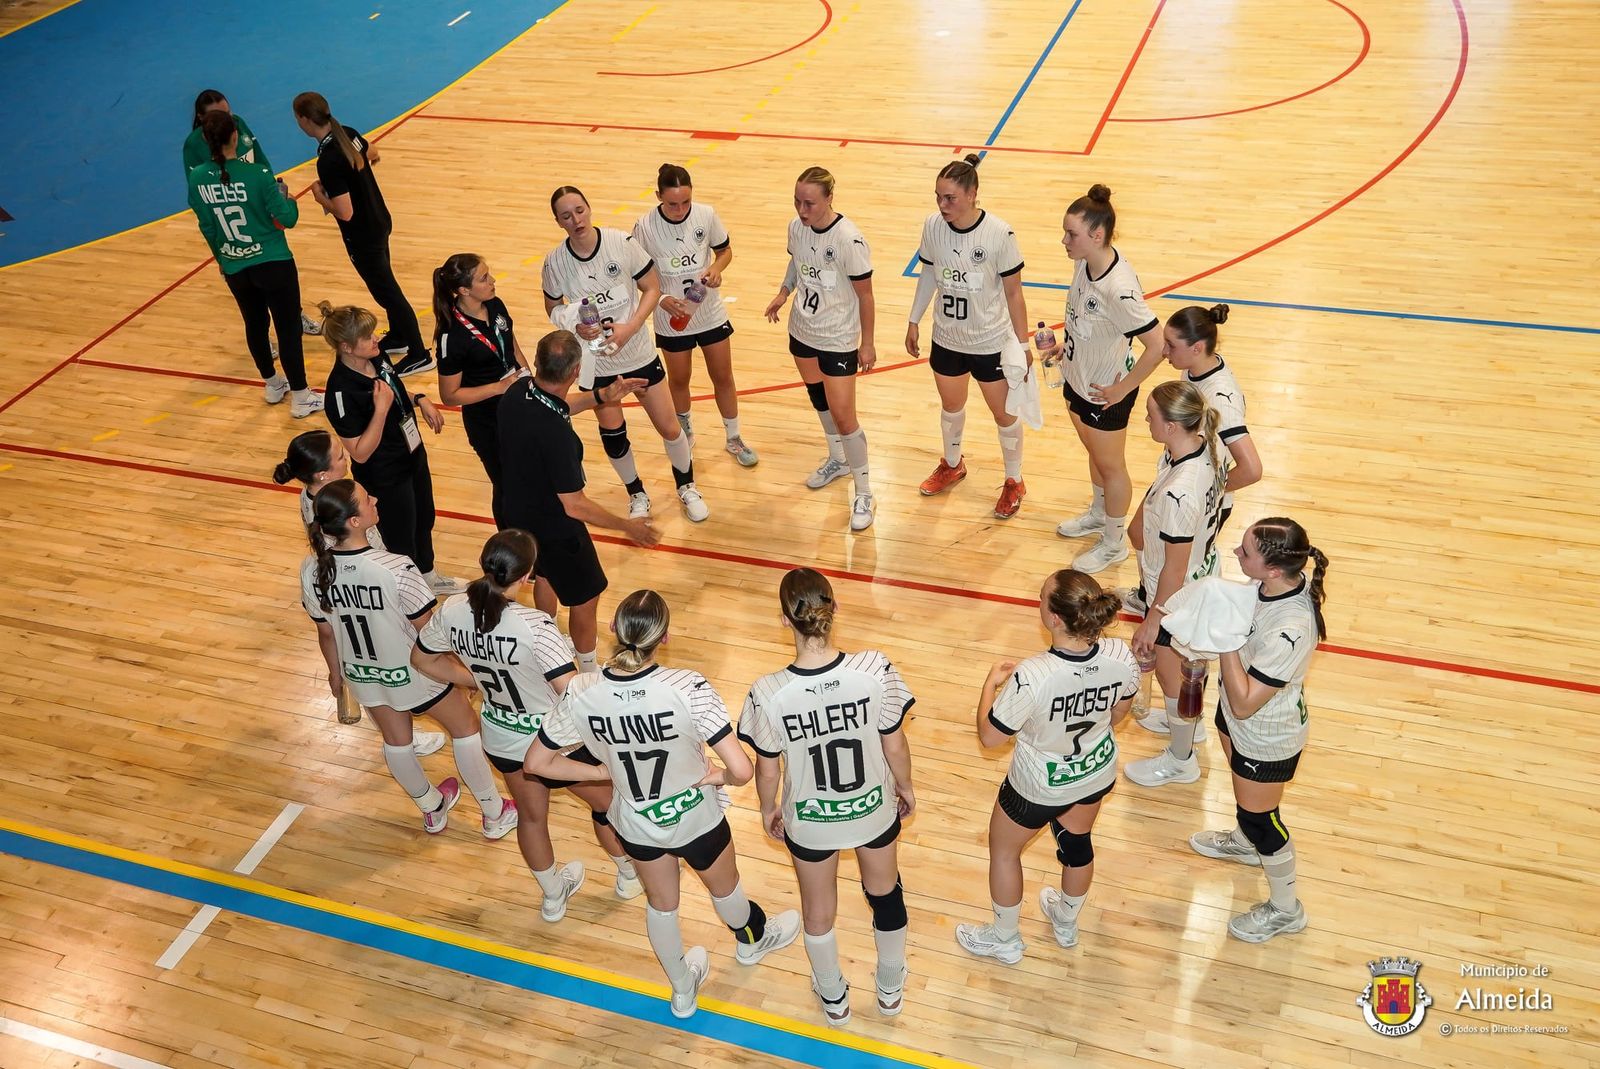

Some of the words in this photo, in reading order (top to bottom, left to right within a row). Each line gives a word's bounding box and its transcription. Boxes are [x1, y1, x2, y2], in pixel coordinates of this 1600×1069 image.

[197, 182, 248, 204] WEISS
[213, 205, 253, 242] 12
[220, 242, 262, 257] ALSCO
[803, 288, 819, 315] 14
[942, 294, 968, 320] 20
[340, 614, 378, 661] 11
[450, 626, 520, 665] GAUBATZ
[470, 664, 527, 713] 21
[1049, 682, 1122, 722] PROBST
[782, 697, 871, 742] EHLERT
[1050, 738, 1113, 781] ALSCO
[1063, 721, 1097, 762] 7
[616, 748, 670, 803] 17
[808, 738, 866, 793] 10
[799, 789, 881, 816] ALSCO
